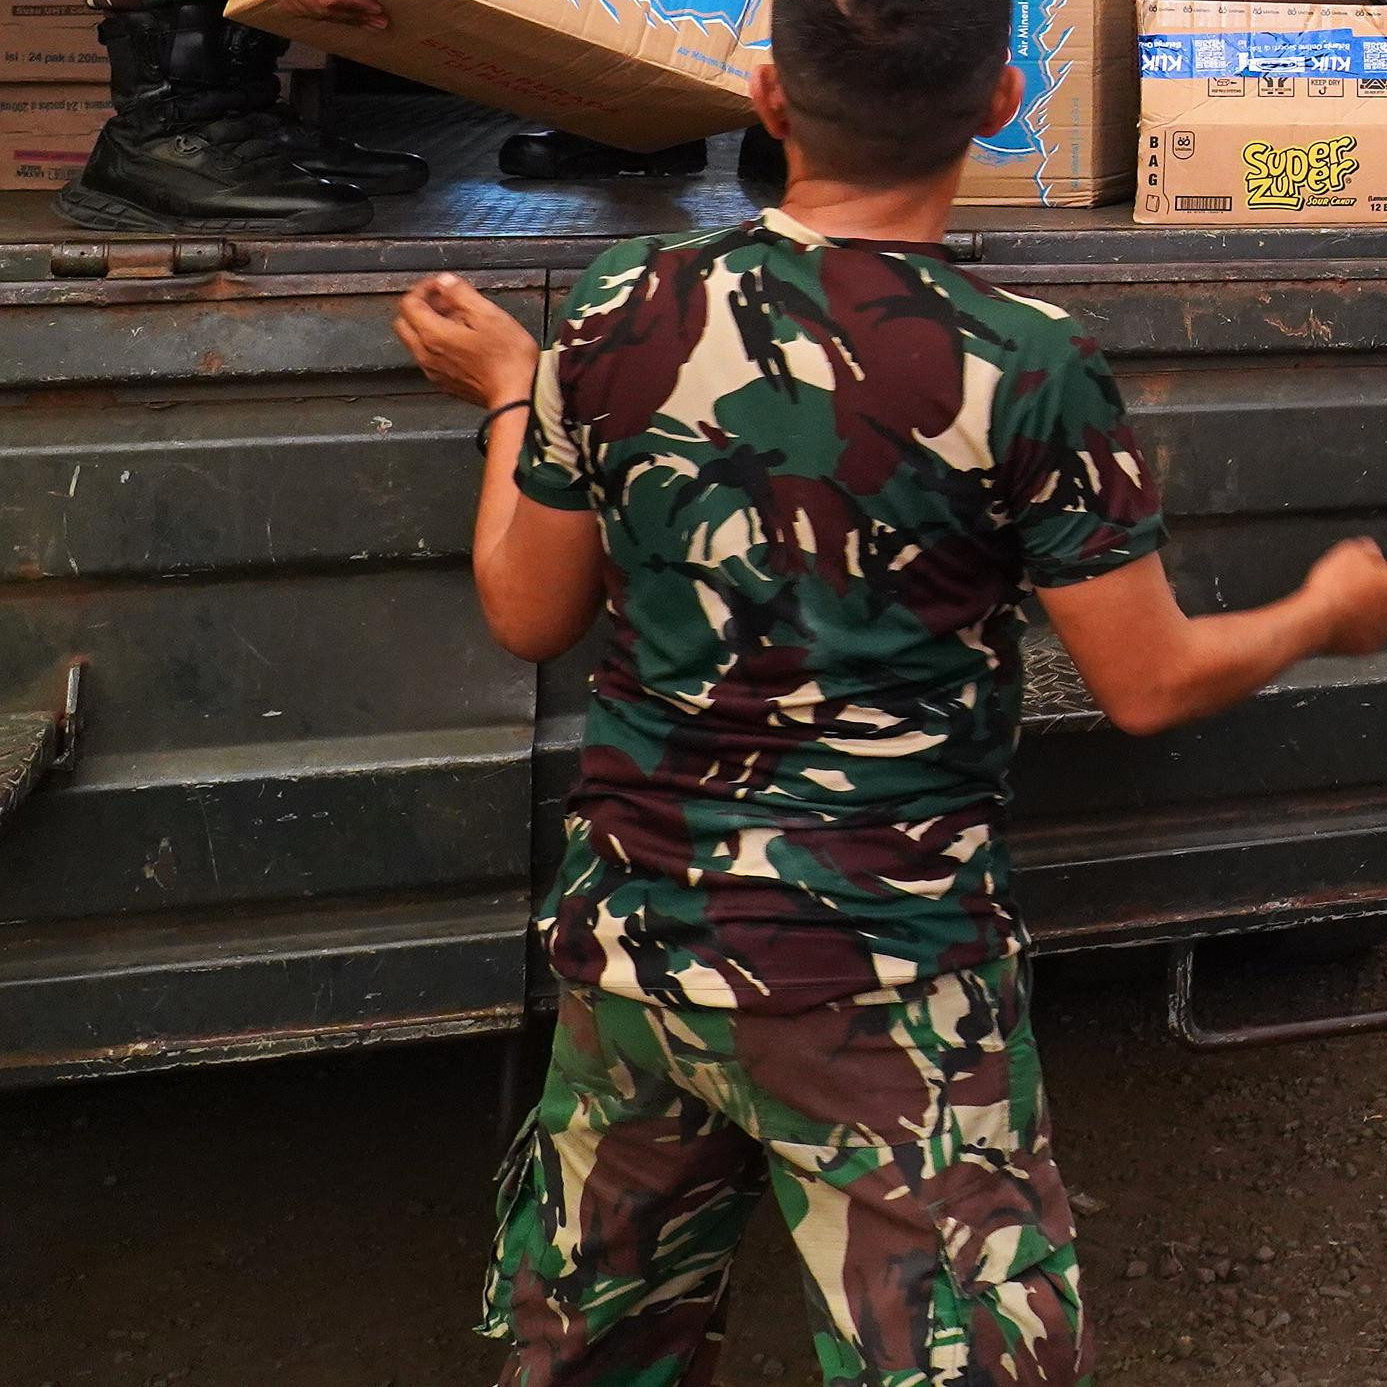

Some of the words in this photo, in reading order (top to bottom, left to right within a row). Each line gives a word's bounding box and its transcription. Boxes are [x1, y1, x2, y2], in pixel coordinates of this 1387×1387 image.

[1018, 1, 1029, 39] Mineral
[1018, 41, 1029, 57] Air
[77, 52, 109, 63] 200m
[1242, 135, 1358, 183] Super
[1370, 203, 1381, 212] 12
